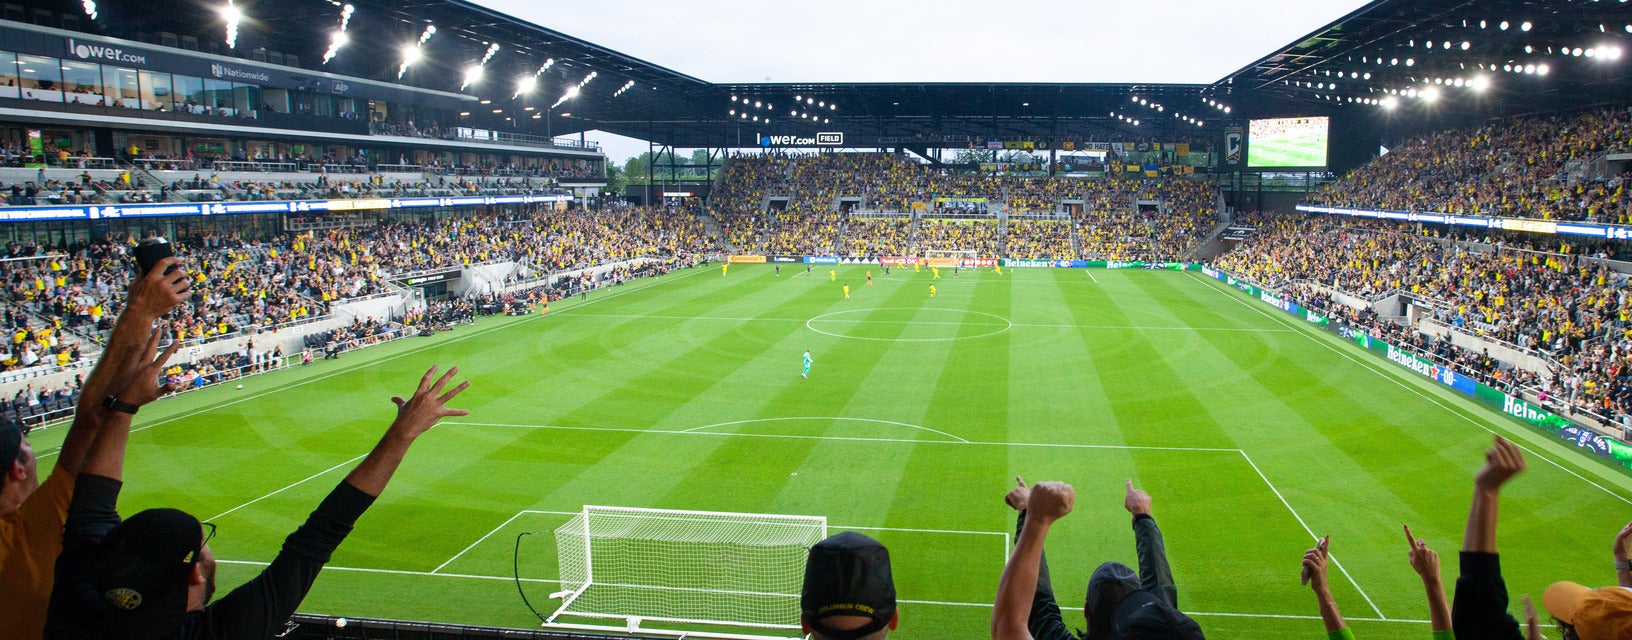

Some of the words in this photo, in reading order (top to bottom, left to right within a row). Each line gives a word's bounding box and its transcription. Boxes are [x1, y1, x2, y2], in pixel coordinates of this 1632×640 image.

[223, 67, 269, 82] Nationwide
[1004, 259, 1048, 267] Heineken
[1387, 344, 1430, 377] Heineken
[854, 604, 874, 614] CREW
